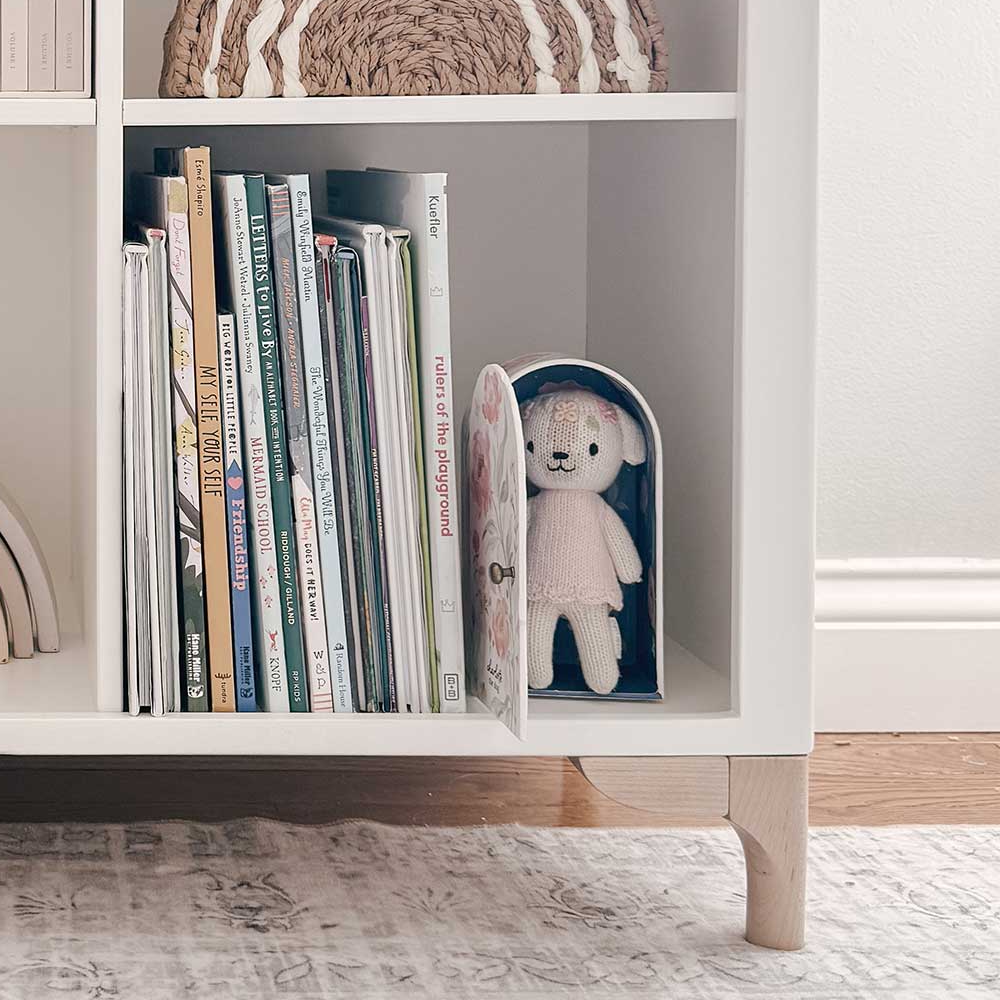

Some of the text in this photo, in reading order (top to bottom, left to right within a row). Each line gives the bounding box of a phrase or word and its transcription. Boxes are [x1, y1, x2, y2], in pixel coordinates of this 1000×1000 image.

[194, 159, 206, 217] Esmé Shapiro
[428, 195, 441, 239] Kuefler
[250, 214, 270, 282] LETTERS
[296, 191, 313, 302] Emily Winfield Martin
[233, 197, 254, 374] JoAnne Stewart Wetzel Julianna Swaney
[257, 286, 271, 301] to
[223, 323, 234, 338] BIG
[257, 305, 272, 337] Live
[287, 328, 298, 360] ANDREA
[199, 366, 217, 387] MY
[265, 361, 272, 370] AN
[266, 372, 277, 406] ALPHABET
[290, 362, 301, 408] STEGMAIER
[226, 392, 236, 420] LITTLE
[269, 409, 279, 425] BOOK
[203, 430, 221, 463] YOUR
[273, 441, 284, 482] INTENTION
[309, 367, 334, 536] The Wonderful Things You Will Be
[435, 355, 453, 537] rulers of the playground
[204, 469, 222, 497] SELF
[250, 437, 272, 554] MERMAID SCHOOL
[230, 498, 248, 591] Friendship
[280, 531, 292, 579] RIDDIOUGH
[304, 543, 313, 564] DOES
[307, 579, 317, 598] HER
[285, 588, 295, 624] GILLAND
[309, 600, 319, 621] WAY!
[192, 633, 201, 682] Kane Miller
[313, 650, 324, 659] W
[270, 657, 281, 692] KNOPF
[336, 653, 347, 708] Random House
[293, 684, 301, 702] KIDS
